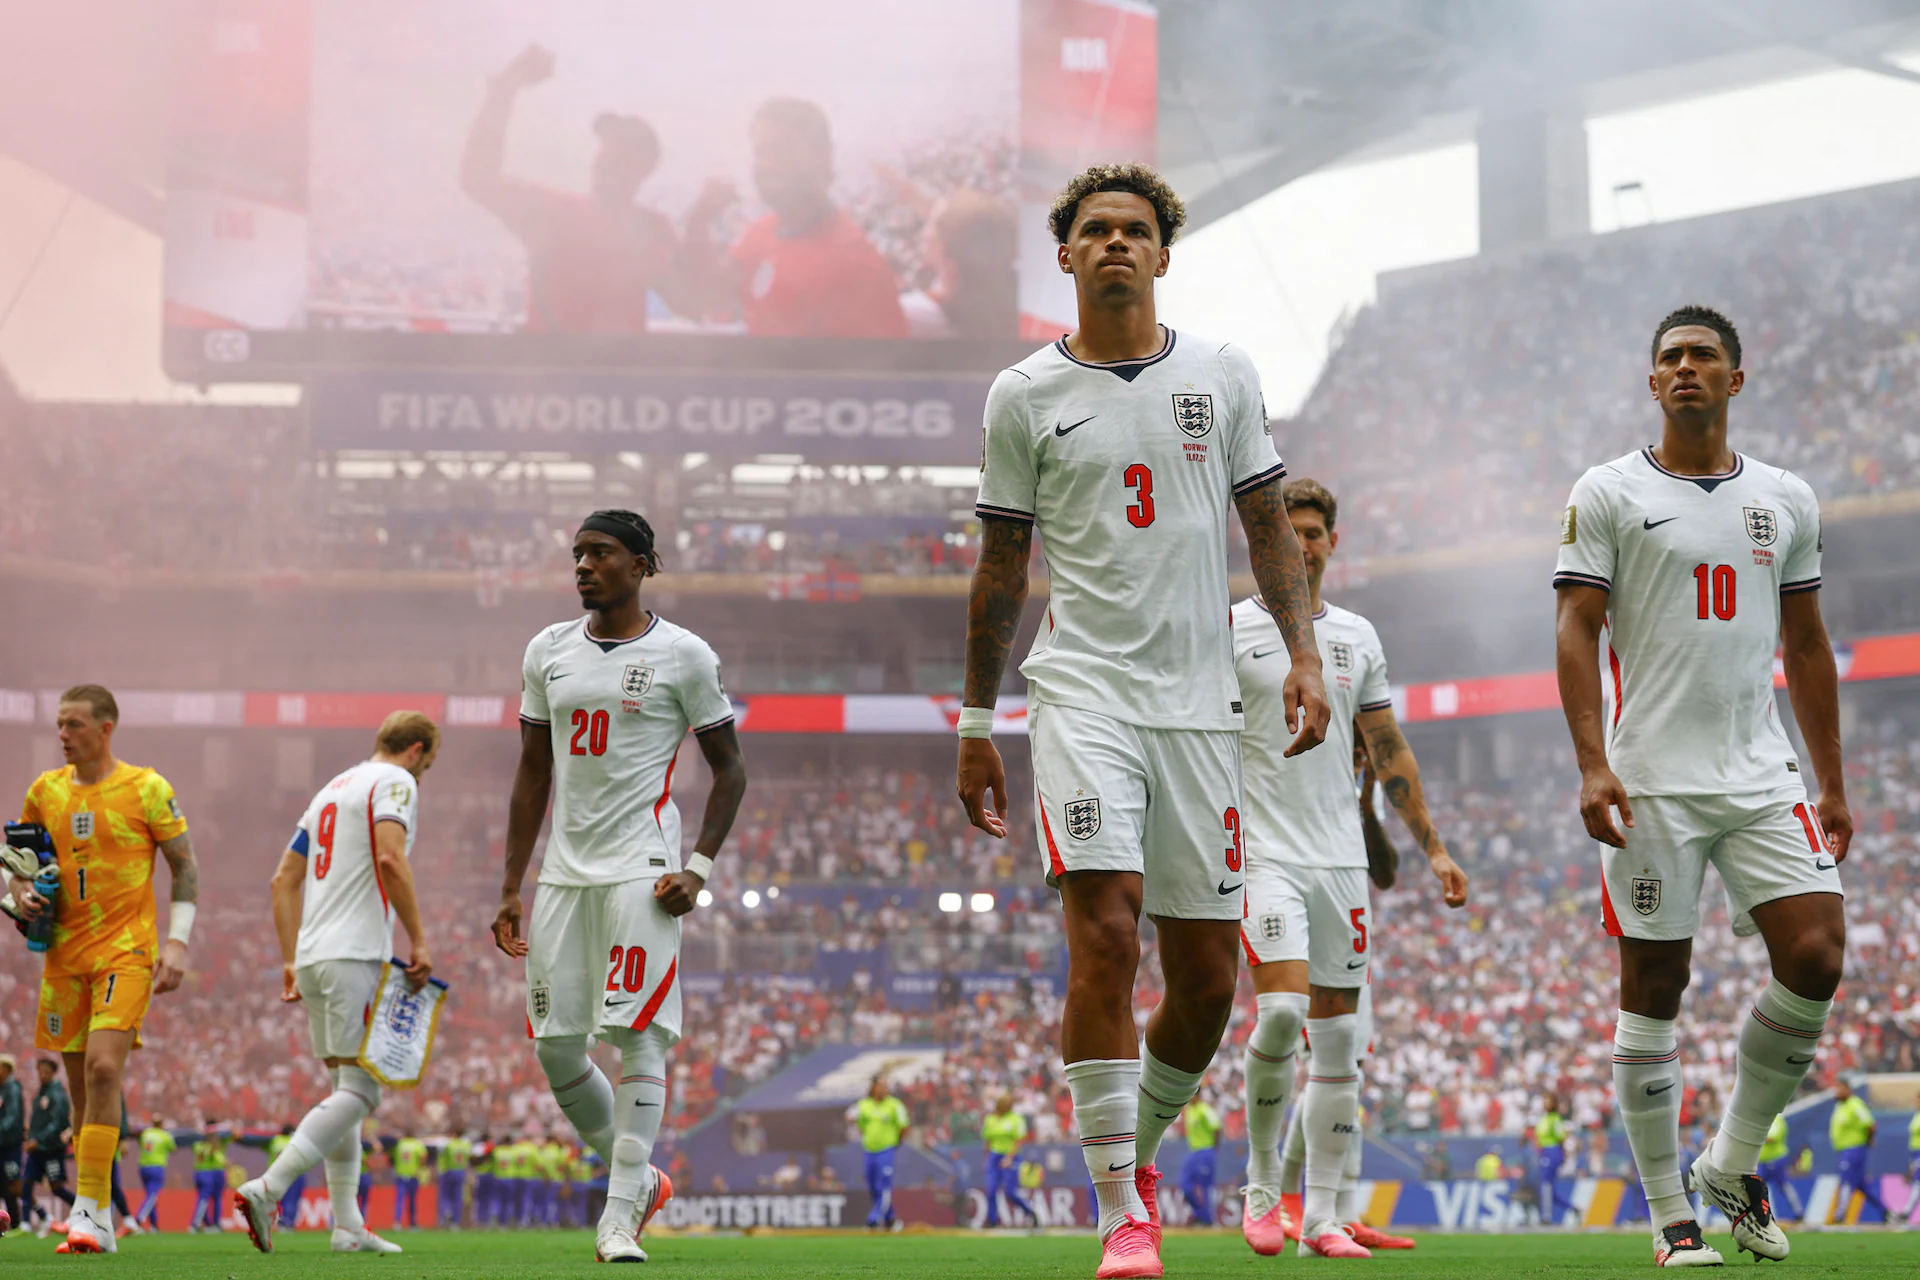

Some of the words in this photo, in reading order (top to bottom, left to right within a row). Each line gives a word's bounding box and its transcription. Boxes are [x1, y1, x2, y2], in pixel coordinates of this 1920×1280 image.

[378, 393, 484, 432] FIFA
[490, 393, 671, 433] WORLD
[677, 395, 776, 436] CUP
[784, 398, 955, 440] 2026
[1182, 443, 1208, 453] NORWAY
[1124, 463, 1155, 529] 3
[1693, 563, 1736, 621] 10
[570, 708, 610, 756] 20
[315, 802, 337, 880] 9
[1223, 806, 1242, 872] 3
[77, 866, 87, 902] 1
[1349, 907, 1367, 954] 5
[104, 973, 117, 1005] 1
[606, 945, 647, 993] 20
